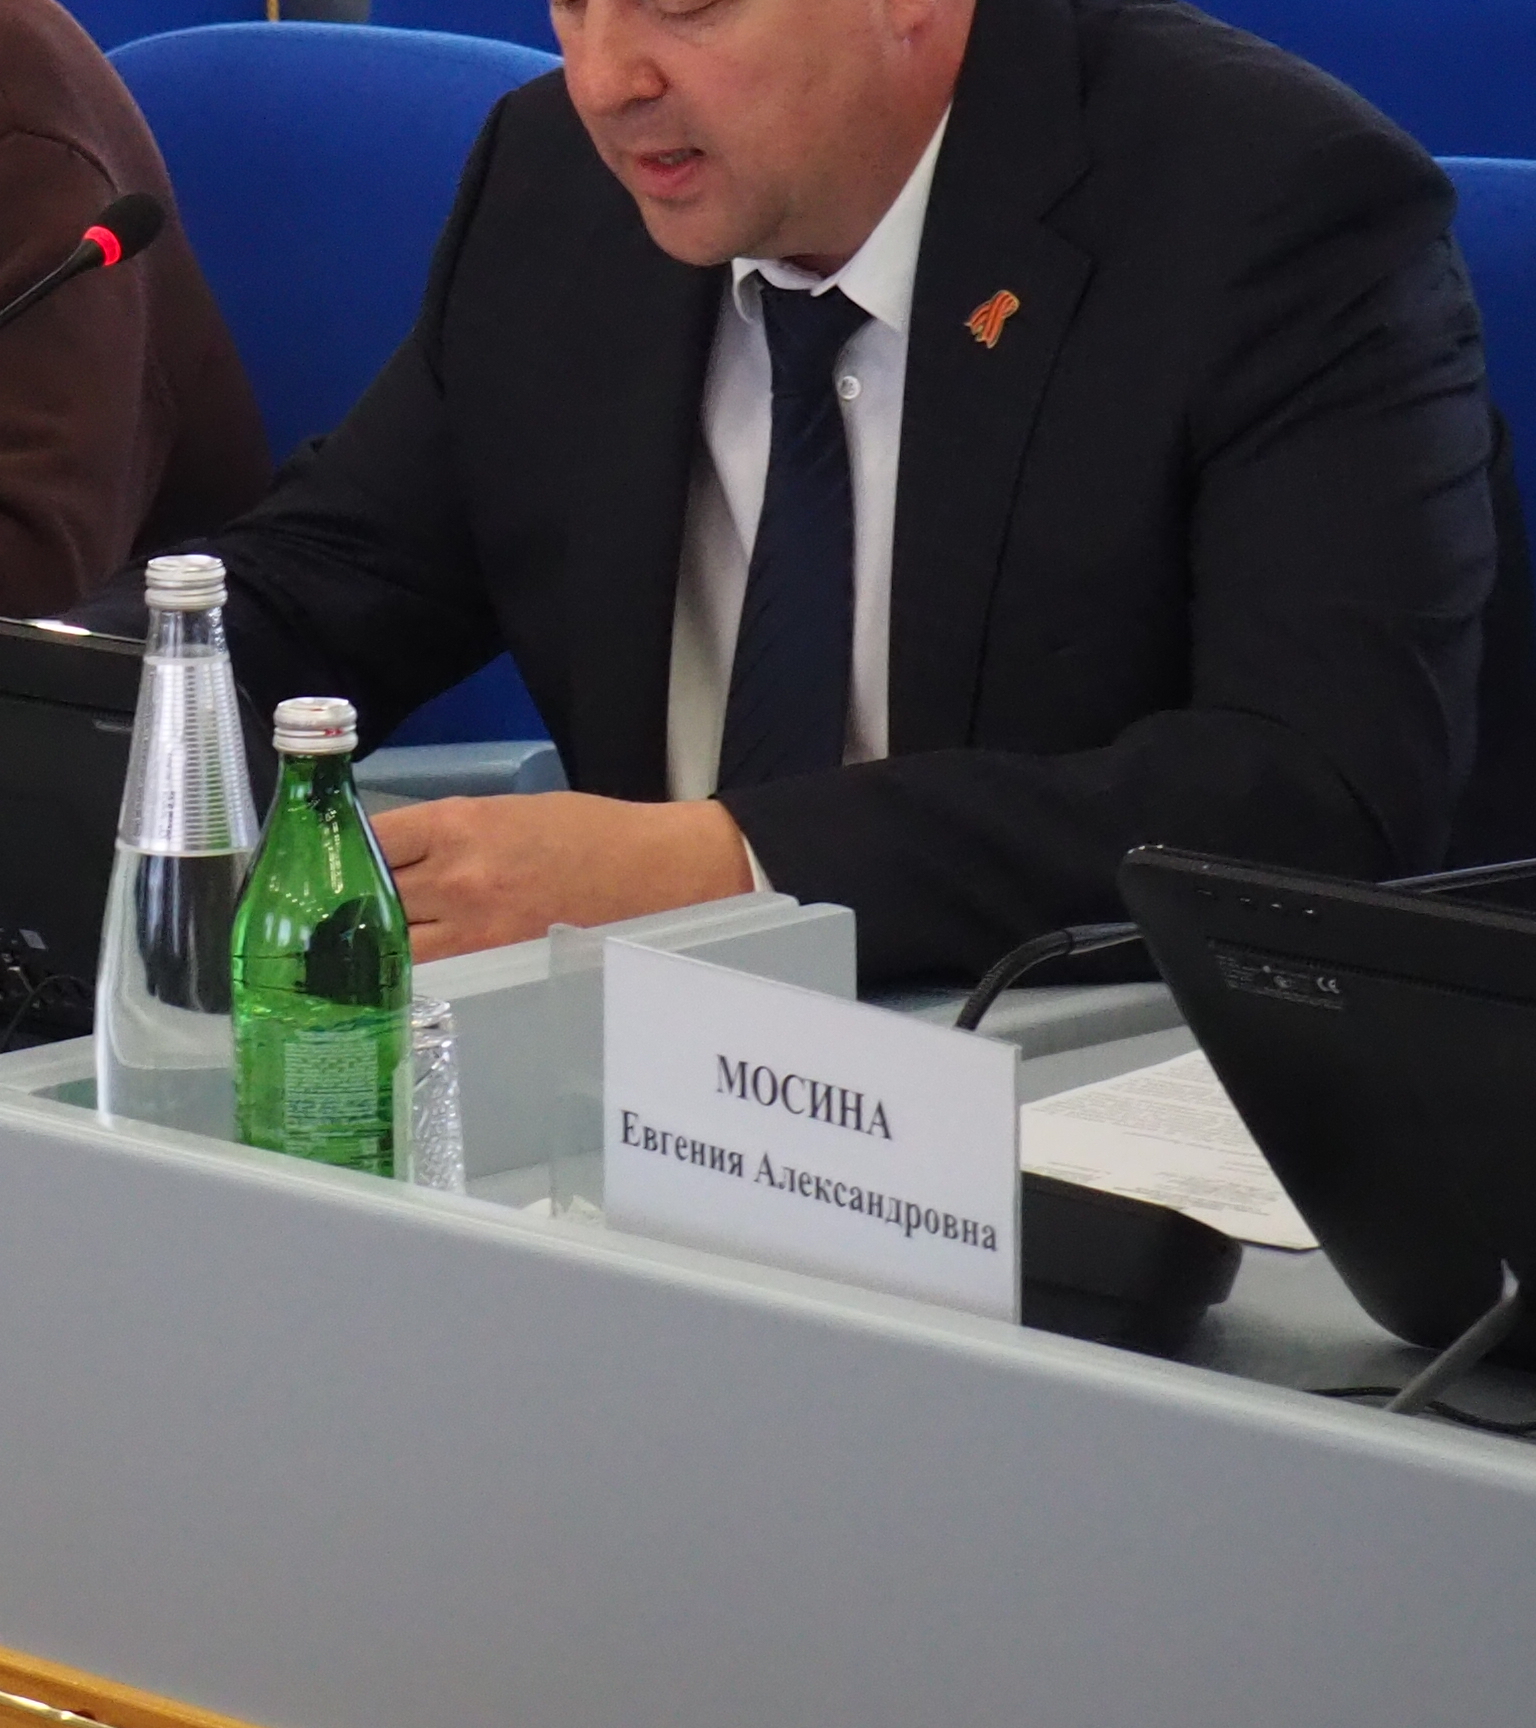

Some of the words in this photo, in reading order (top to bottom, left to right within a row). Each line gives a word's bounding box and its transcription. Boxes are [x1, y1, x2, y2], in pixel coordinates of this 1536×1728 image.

[716, 1054, 894, 1141] МОСИНА
[620, 1109, 744, 1179] Евгения
[754, 1151, 999, 1253] Александровна
